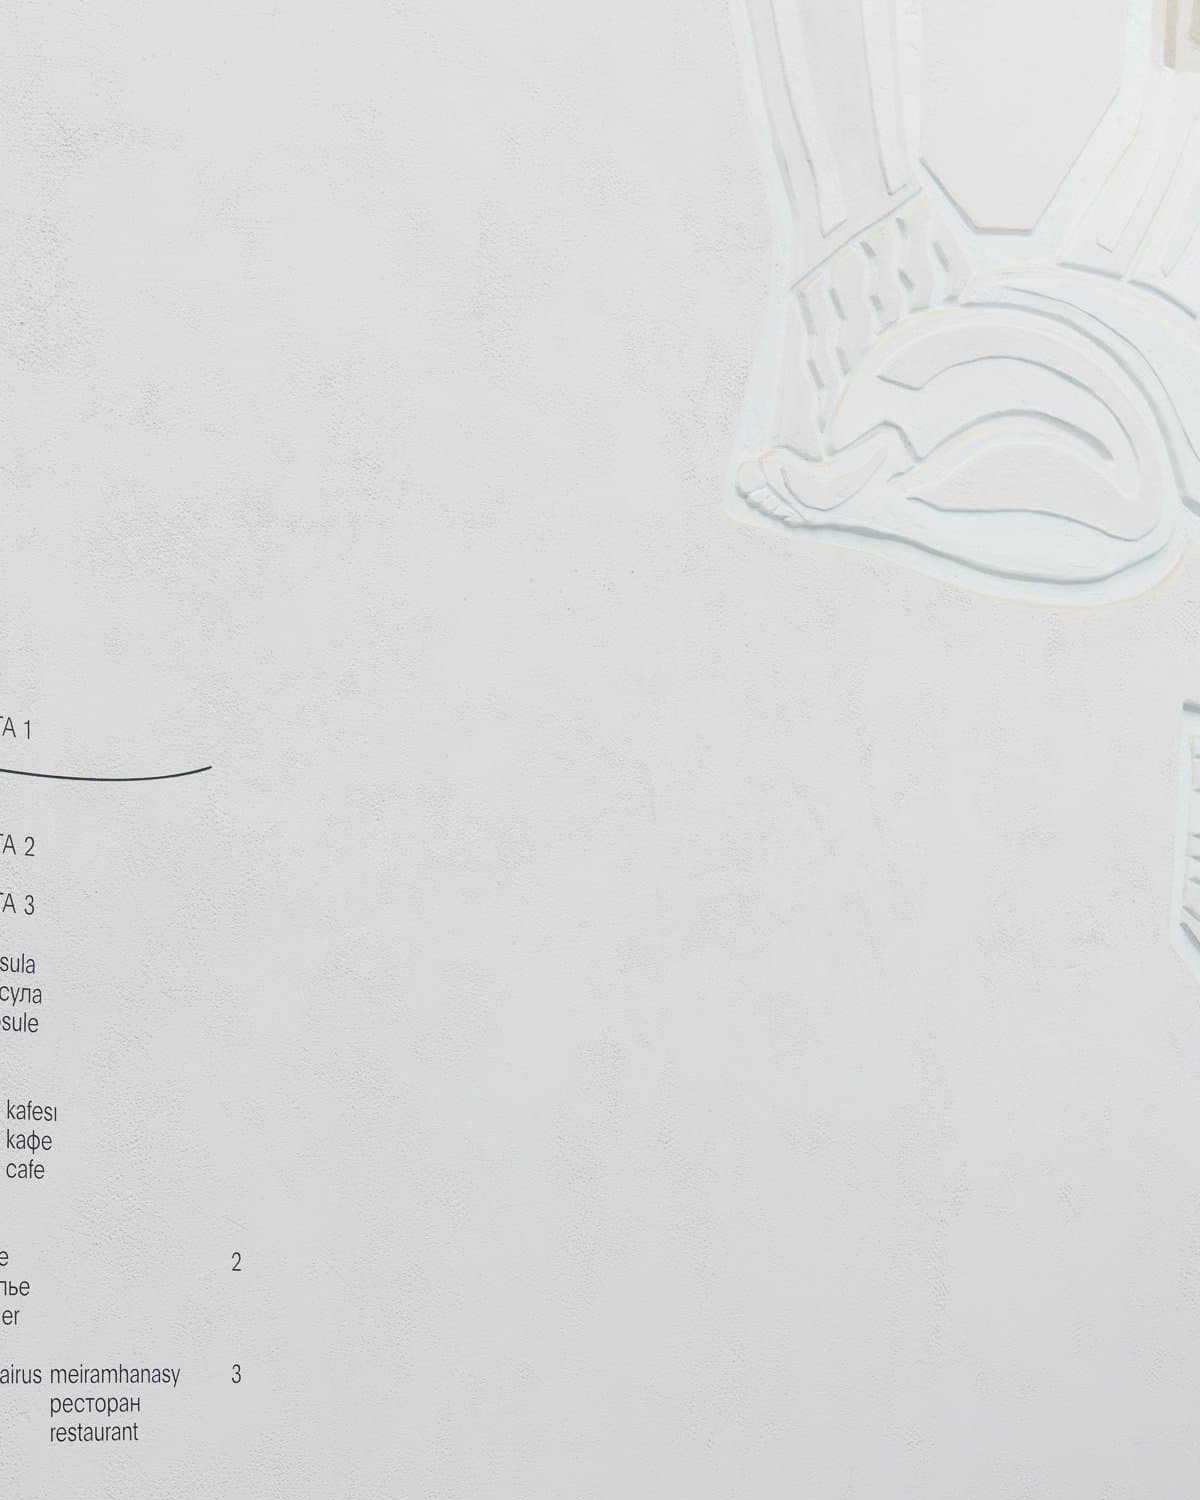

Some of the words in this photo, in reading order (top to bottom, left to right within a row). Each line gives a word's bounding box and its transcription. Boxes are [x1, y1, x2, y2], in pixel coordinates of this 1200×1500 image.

[23, 719, 32, 740] 1
[24, 835, 36, 857] 2
[23, 894, 36, 916] 3
[5, 1158, 45, 1180] cafe
[231, 1251, 242, 1272] 2
[50, 1363, 181, 1388] meiramhanasy
[231, 1363, 242, 1384] 3
[50, 1396, 141, 1419] ресторан
[50, 1422, 139, 1443] restaurant
